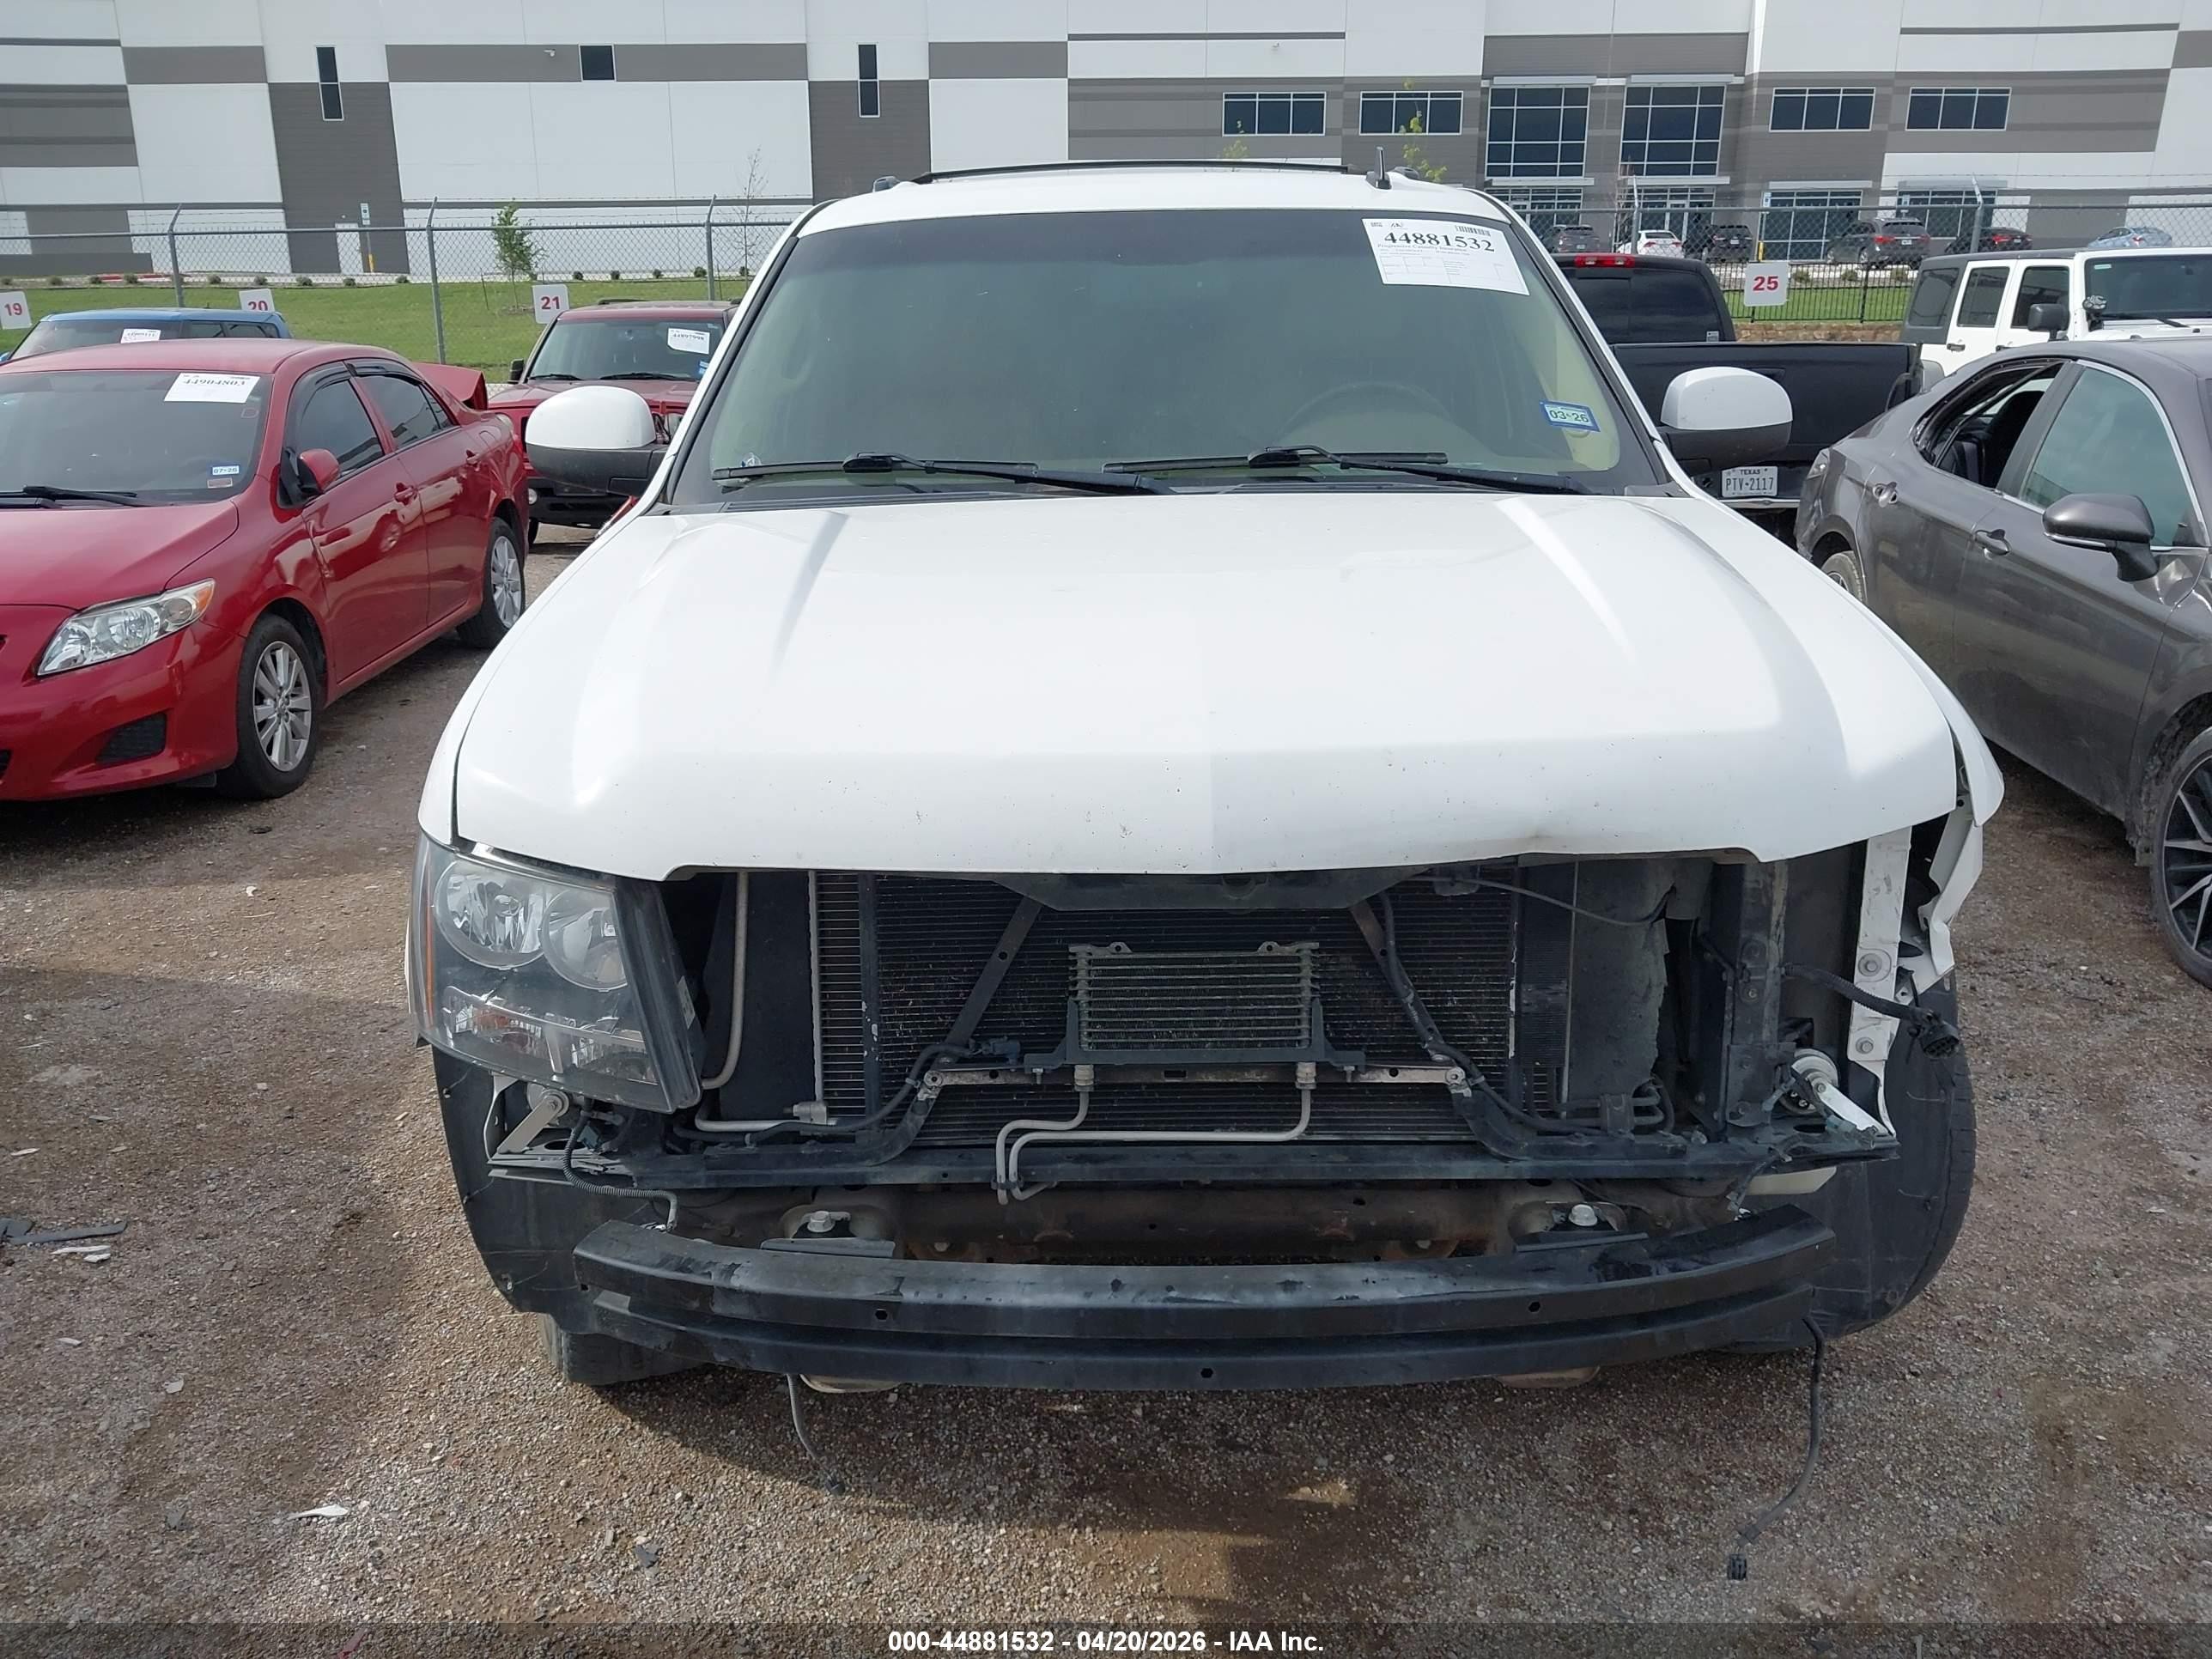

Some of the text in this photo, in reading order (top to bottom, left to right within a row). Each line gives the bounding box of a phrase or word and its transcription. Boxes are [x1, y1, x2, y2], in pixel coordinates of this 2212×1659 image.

[1384, 231, 1495, 252] 44881532
[1752, 276, 1779, 291] 25
[3, 302, 23, 316] 19
[247, 300, 269, 312] 20
[540, 295, 561, 310] 21
